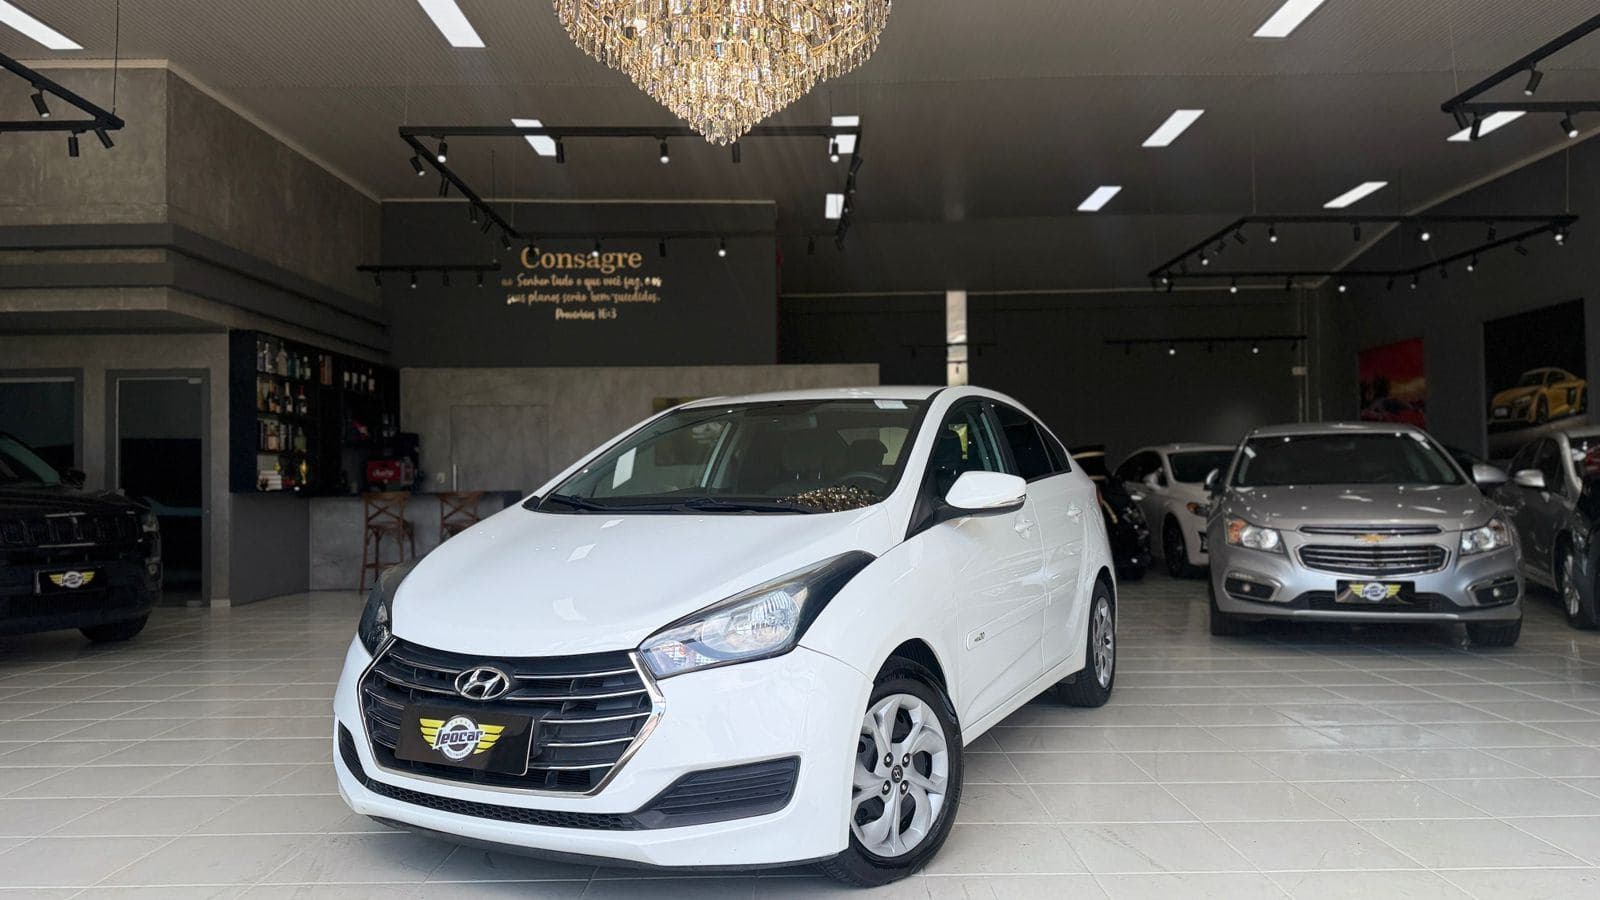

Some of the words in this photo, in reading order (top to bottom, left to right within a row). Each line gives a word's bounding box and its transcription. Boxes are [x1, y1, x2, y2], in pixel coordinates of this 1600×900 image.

[520, 246, 643, 274] Consagre
[517, 272, 550, 287] Senhor
[551, 274, 574, 287] tudo
[583, 277, 601, 291] que
[528, 290, 560, 306] planos
